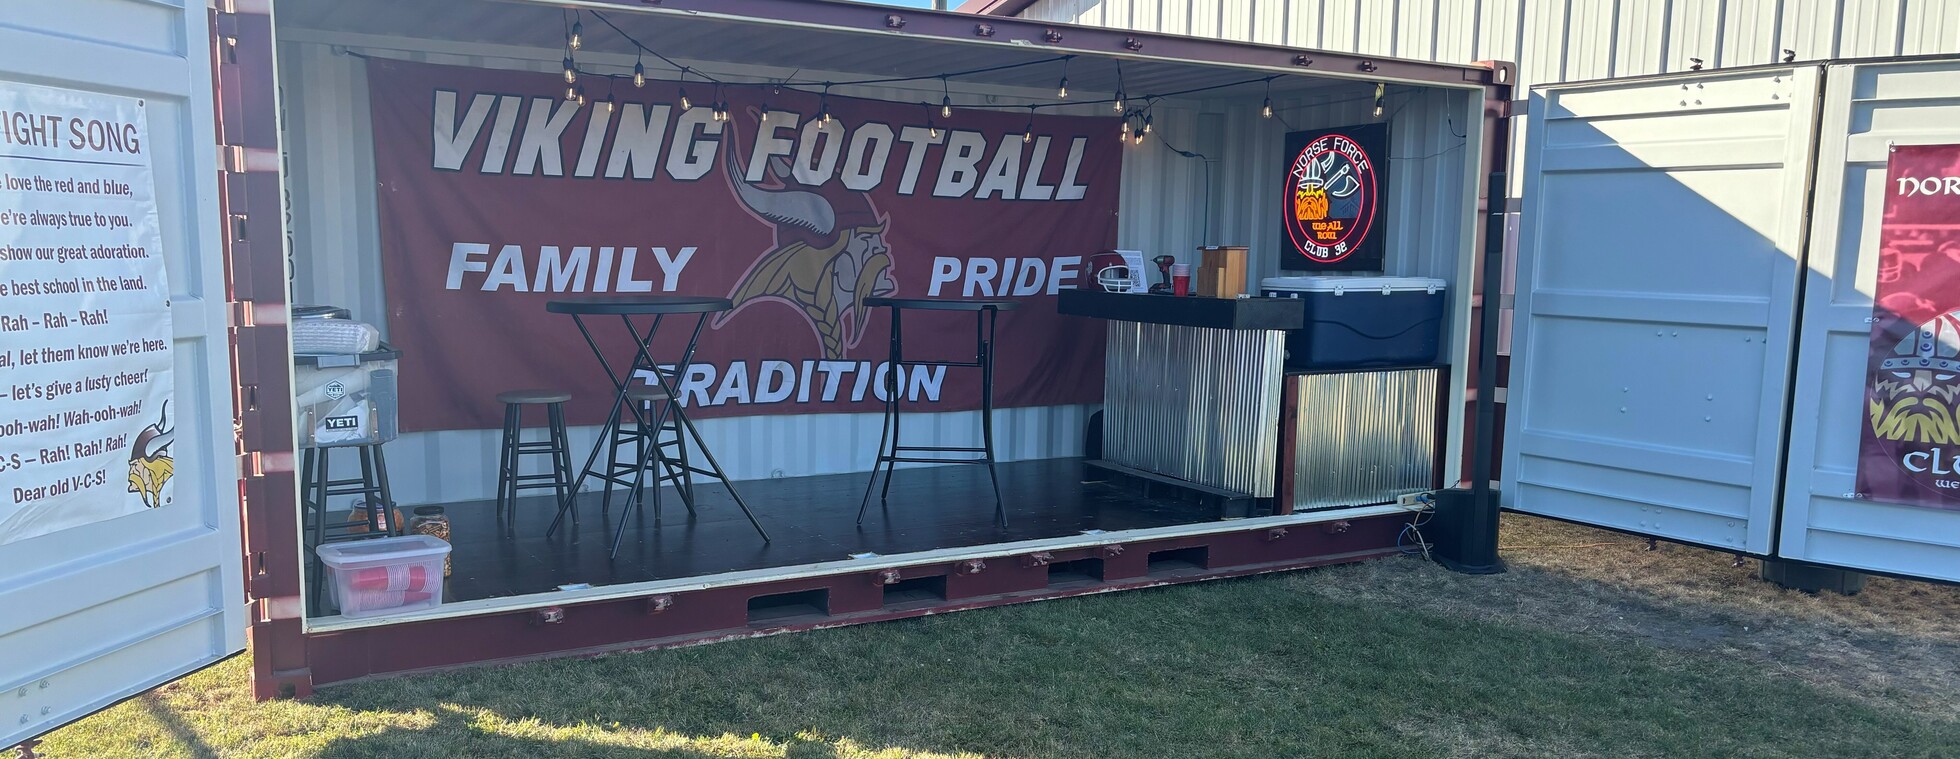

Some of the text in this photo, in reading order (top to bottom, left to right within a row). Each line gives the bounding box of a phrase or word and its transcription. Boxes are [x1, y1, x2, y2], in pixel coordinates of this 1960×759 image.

[69, 118, 141, 154] SONG
[433, 90, 1088, 201] VIKING FOOTBALL
[1293, 137, 1369, 178] NORSE FORCE
[5, 173, 32, 191] love
[34, 175, 52, 192] the
[55, 177, 74, 193] red
[77, 178, 99, 194] and
[103, 179, 133, 198] blue,
[30, 210, 67, 230] always
[69, 211, 92, 227] true
[95, 212, 107, 227] to
[109, 214, 133, 231] you.
[0, 245, 149, 263] show our great adoration.
[1304, 240, 1328, 258] CLUB
[445, 242, 698, 293] FAMILY
[927, 255, 1082, 297] PRIDE
[12, 279, 40, 296] best
[43, 278, 79, 295] school
[82, 278, 95, 292] in
[97, 278, 118, 291] the
[119, 275, 147, 289] land.
[2, 315, 28, 332] Rah
[43, 312, 68, 329] Rah
[79, 309, 108, 325] Rah!
[20, 348, 38, 365] let
[41, 347, 75, 363] them
[78, 344, 109, 359] know
[111, 340, 140, 355] we're
[142, 338, 167, 351] here.
[12, 384, 42, 401] let's
[46, 380, 72, 399] give
[75, 380, 82, 392] a
[85, 375, 112, 392] lusty
[114, 369, 148, 387] cheer!
[64, 400, 141, 427] Wah-ooh-wah!
[327, 418, 356, 428] YETI
[39, 444, 70, 464] Rah!
[74, 439, 102, 458] Rah!
[105, 433, 127, 452] Rah!
[13, 469, 106, 504] Dear old V-C-S!
